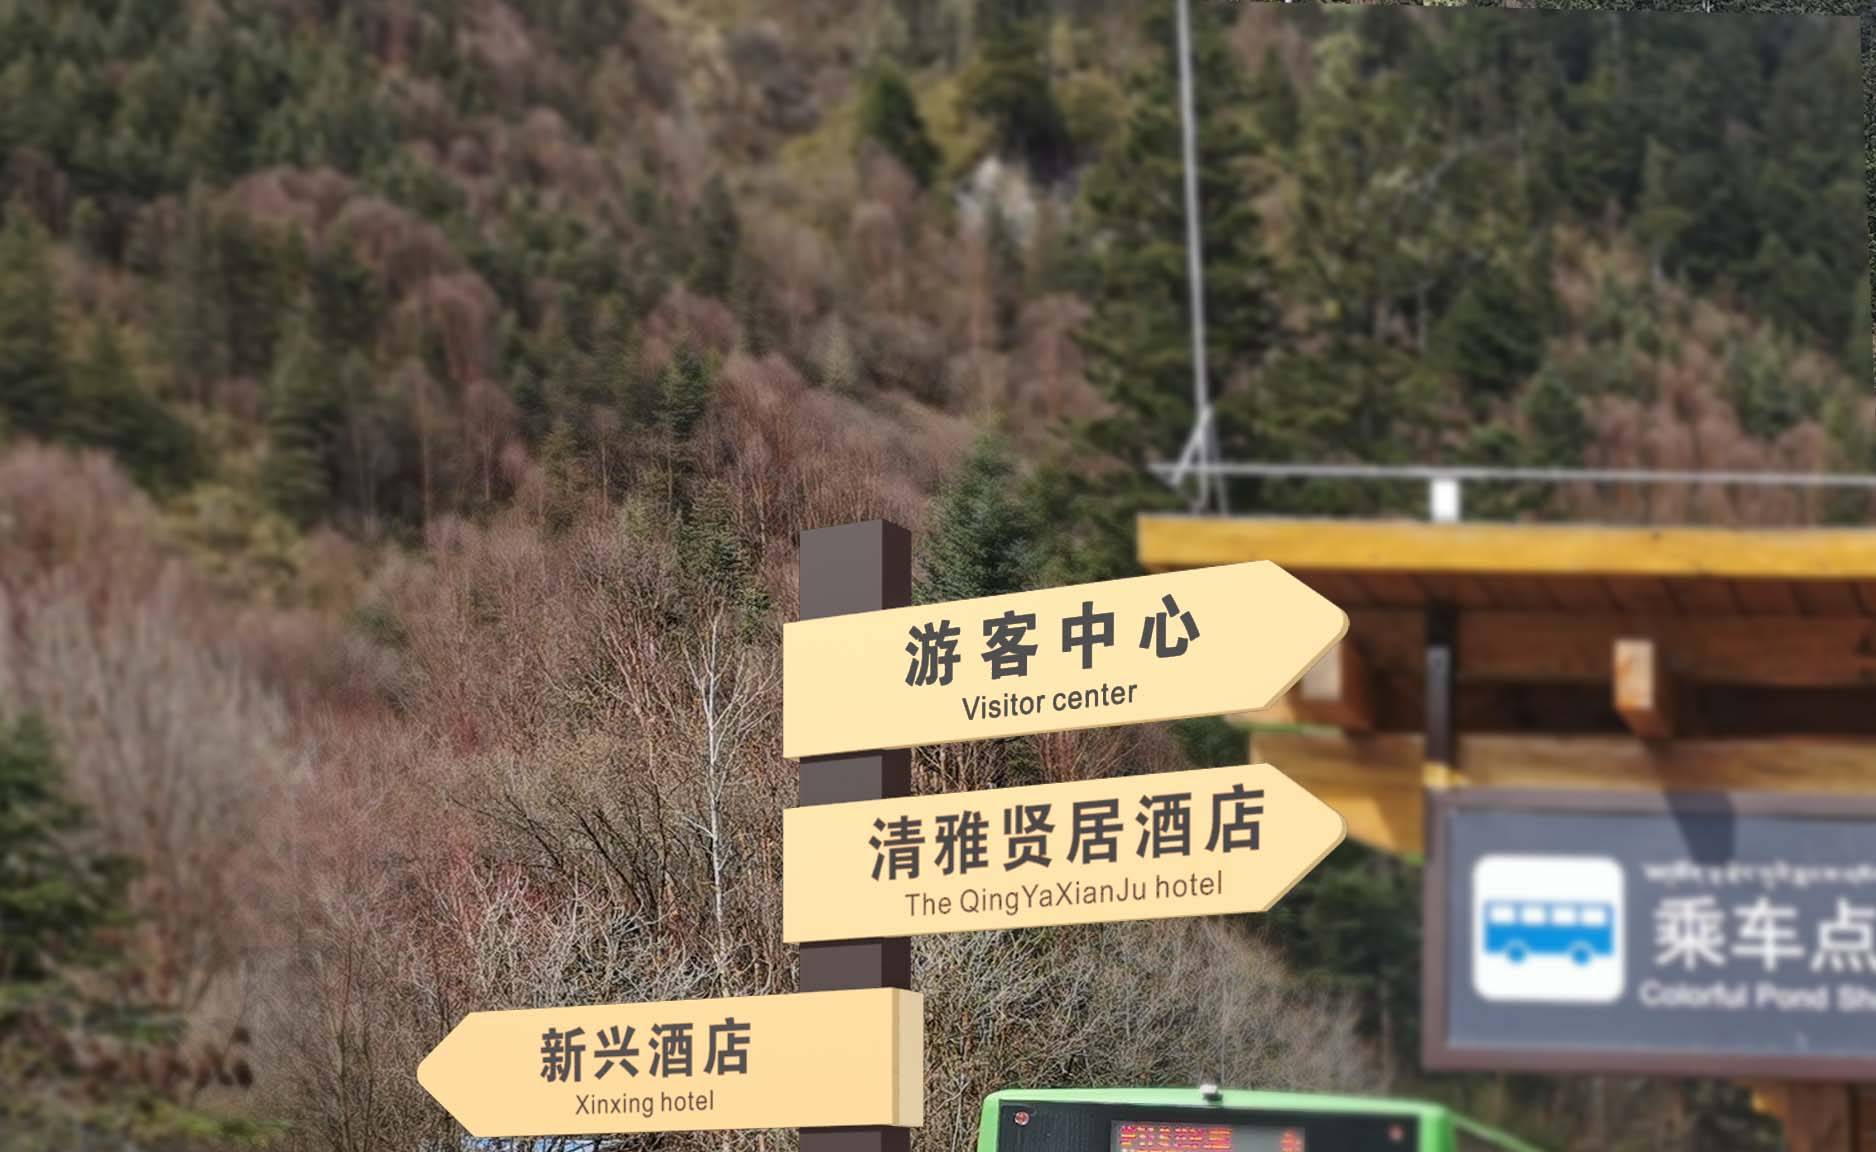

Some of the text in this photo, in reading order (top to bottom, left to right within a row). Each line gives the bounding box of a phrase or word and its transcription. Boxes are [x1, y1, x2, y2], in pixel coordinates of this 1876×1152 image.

[904, 594, 1200, 687] 游客中心
[962, 684, 1137, 721] Visitor center
[869, 784, 1265, 881] 清雅贤居酒店
[905, 871, 1223, 917] The QingYaXianJu hotel
[1653, 896, 1876, 973] 乘车点
[540, 1017, 751, 1083] 新兴酒店
[575, 1090, 714, 1117] Xinxing hotel
